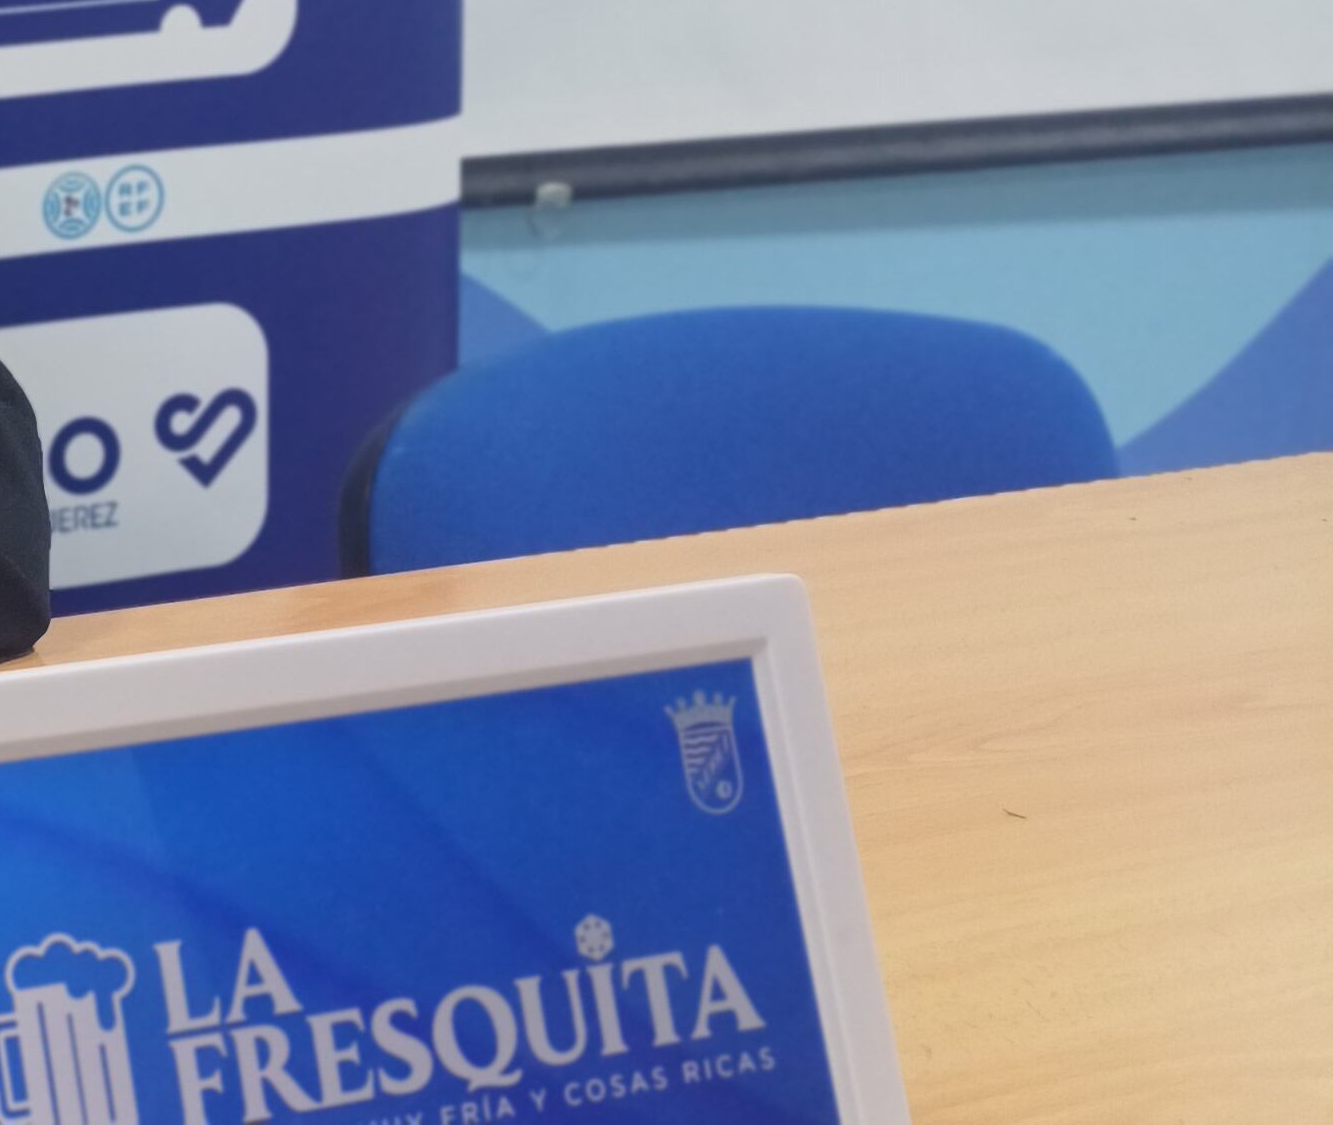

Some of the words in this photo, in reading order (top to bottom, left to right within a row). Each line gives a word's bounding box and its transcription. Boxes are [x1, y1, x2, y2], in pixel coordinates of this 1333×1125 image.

[153, 927, 304, 1036] LA
[167, 943, 766, 1125] FRESQUITA
[529, 1088, 549, 1113] Y
[563, 1067, 669, 1108] COSAS
[681, 1045, 777, 1084] RICAS
